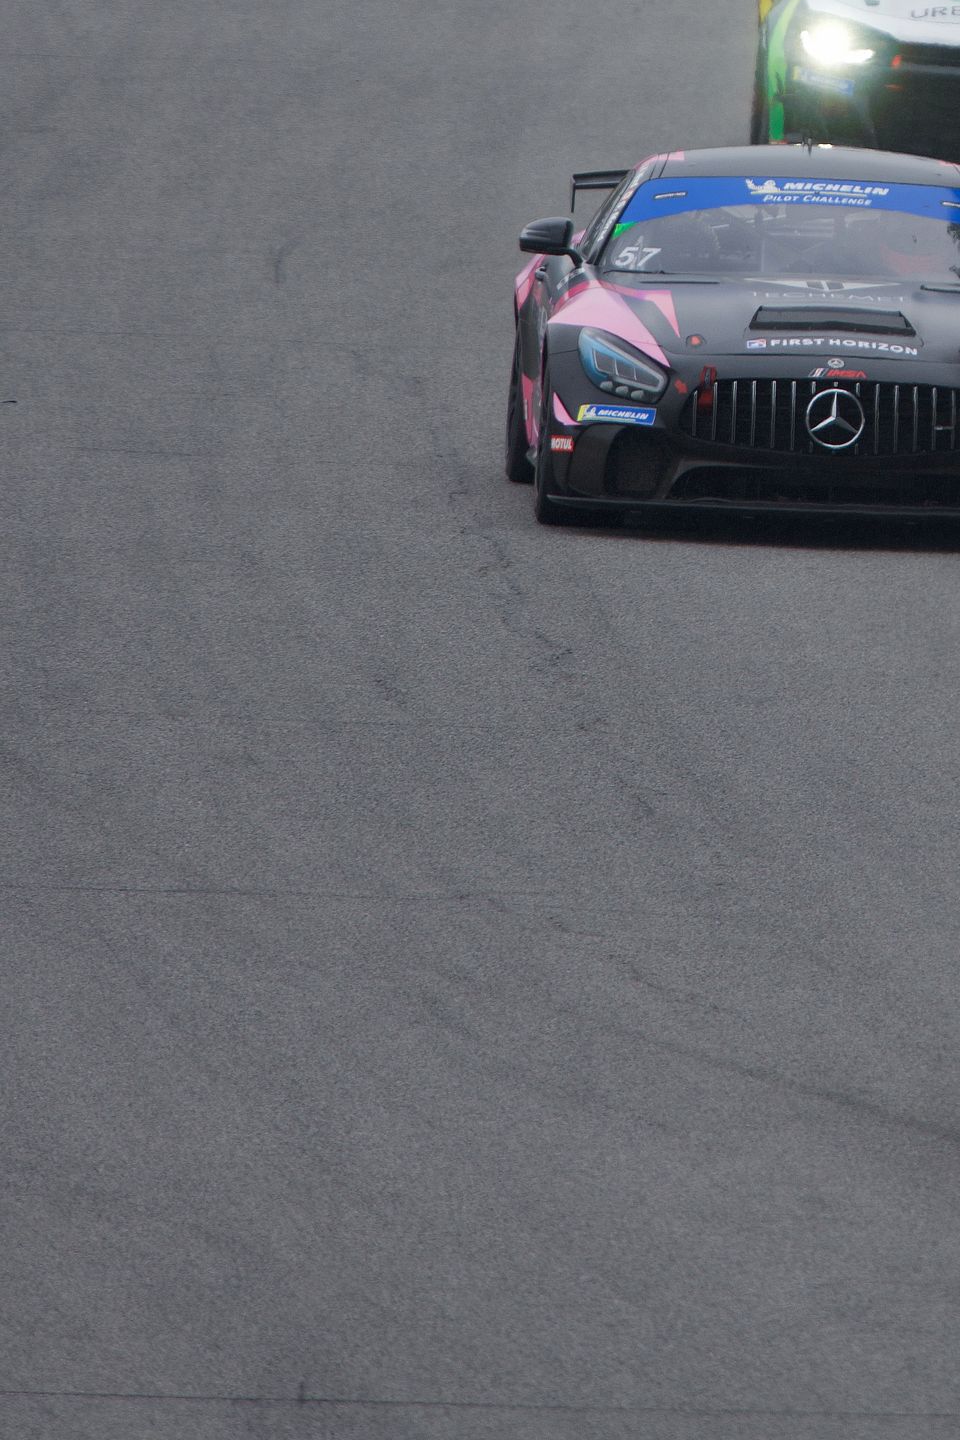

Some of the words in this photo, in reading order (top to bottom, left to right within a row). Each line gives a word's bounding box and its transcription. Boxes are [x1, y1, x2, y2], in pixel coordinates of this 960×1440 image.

[783, 182, 890, 196] MICHELIN
[763, 194, 800, 203] PILOT
[803, 194, 873, 206] CHALLENGE
[614, 246, 662, 267] 57
[770, 338, 825, 347] FIRST
[829, 338, 918, 356] HORIZON
[826, 369, 868, 379] IMSA
[597, 409, 649, 420] MICHELIN
[551, 437, 572, 450] MOTUL
